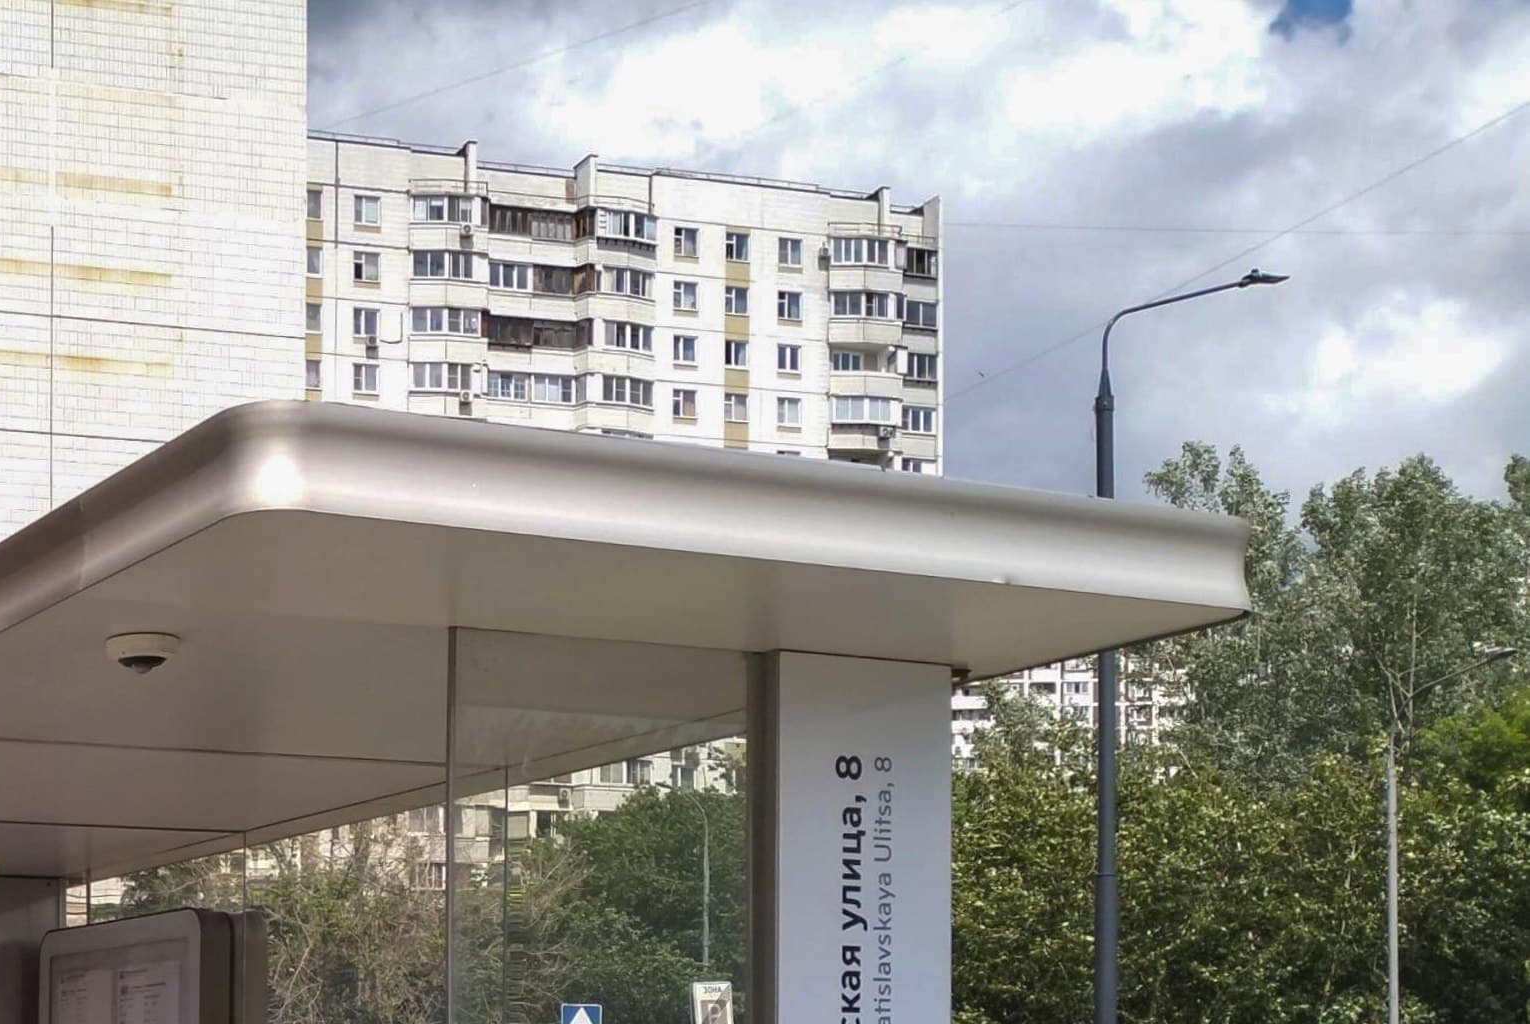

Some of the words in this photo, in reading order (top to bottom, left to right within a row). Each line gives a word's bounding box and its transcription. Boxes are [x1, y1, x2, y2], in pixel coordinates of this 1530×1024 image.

[835, 755, 862, 780] 8
[874, 757, 892, 772] 8
[873, 782, 894, 862] Ulitsa,
[841, 794, 868, 932] улица,
